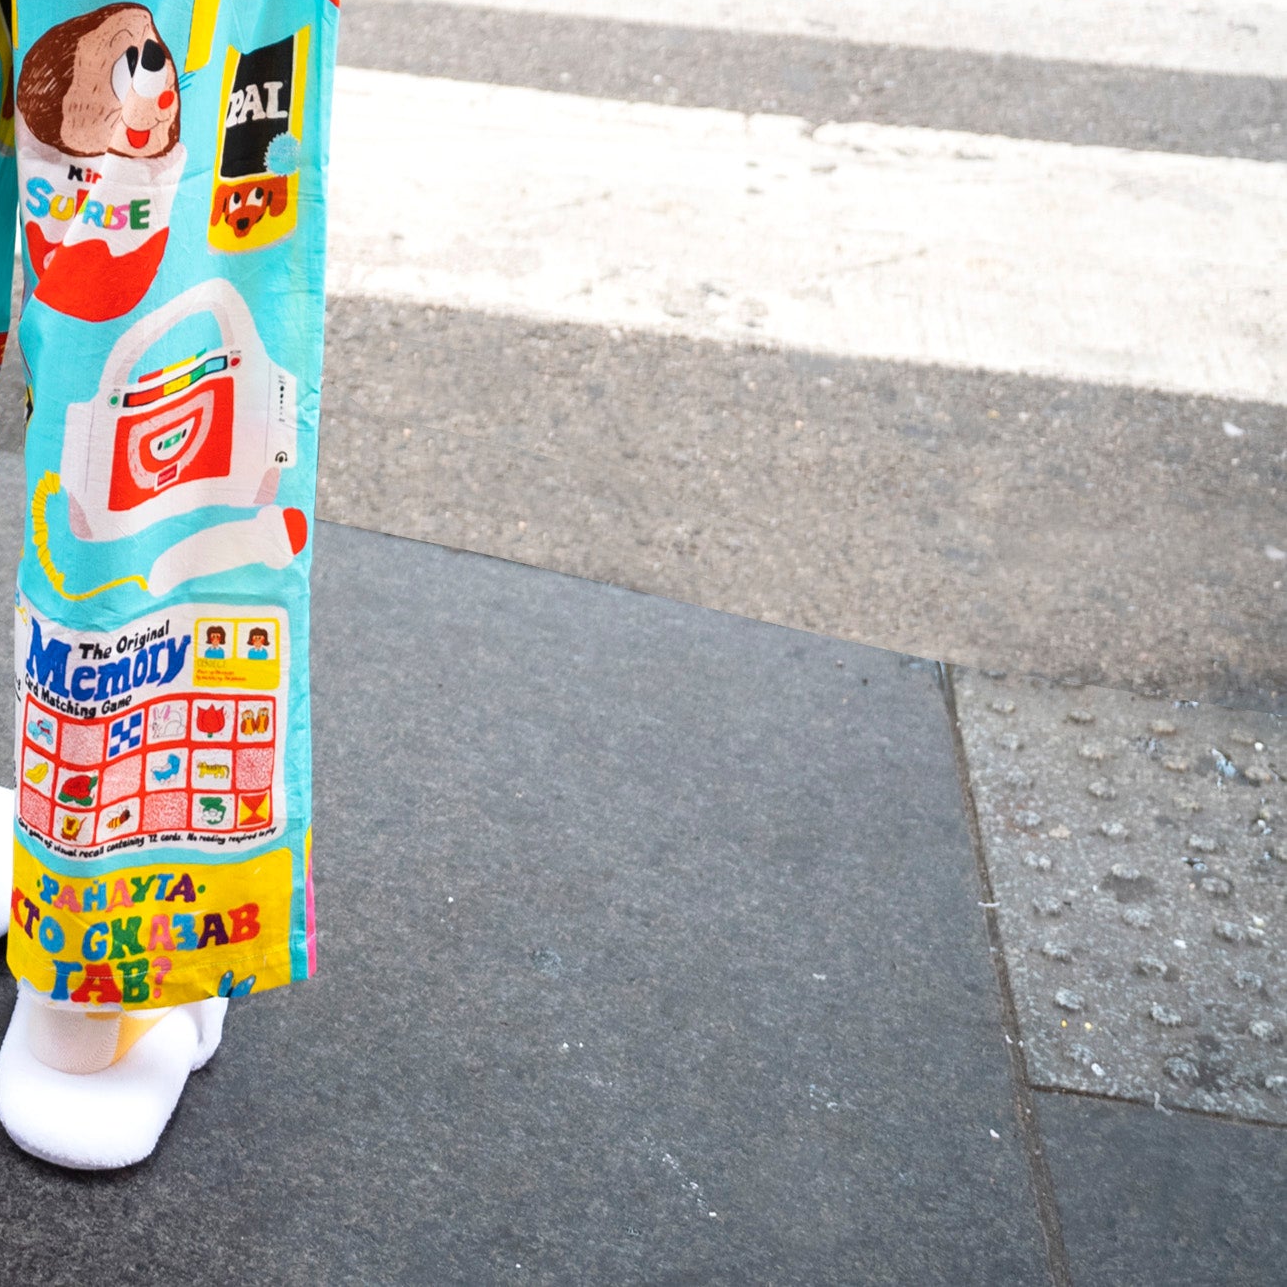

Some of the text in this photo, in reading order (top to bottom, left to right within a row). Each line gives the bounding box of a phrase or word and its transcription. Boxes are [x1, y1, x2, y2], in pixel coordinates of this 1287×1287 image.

[226, 81, 288, 128] PAL
[26, 616, 191, 702] Memory
[79, 619, 170, 660] The Original
[41, 688, 96, 719] Matching
[101, 694, 132, 715] Game
